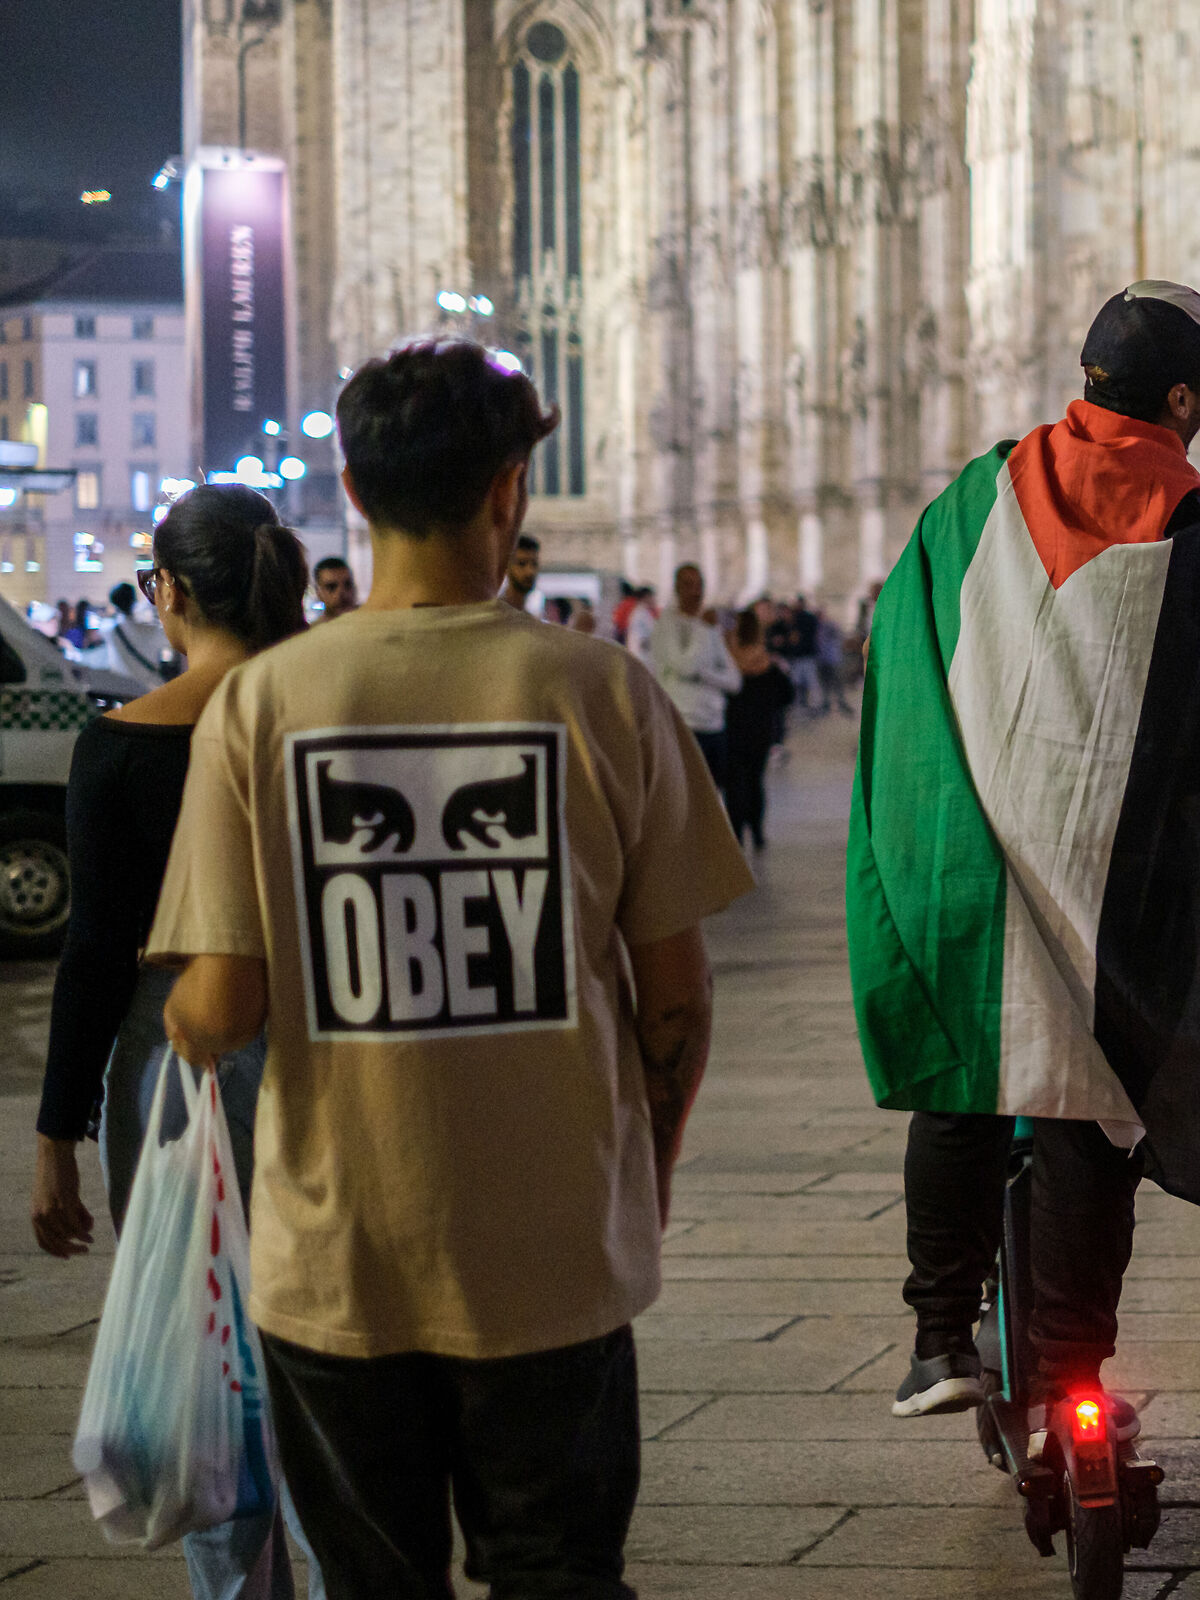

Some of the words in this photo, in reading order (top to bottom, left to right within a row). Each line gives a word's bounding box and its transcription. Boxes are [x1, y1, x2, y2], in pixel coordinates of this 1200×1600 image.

[231, 225, 254, 321] LAUREN
[232, 329, 254, 411] RALPH
[321, 869, 549, 1024] OBEY
